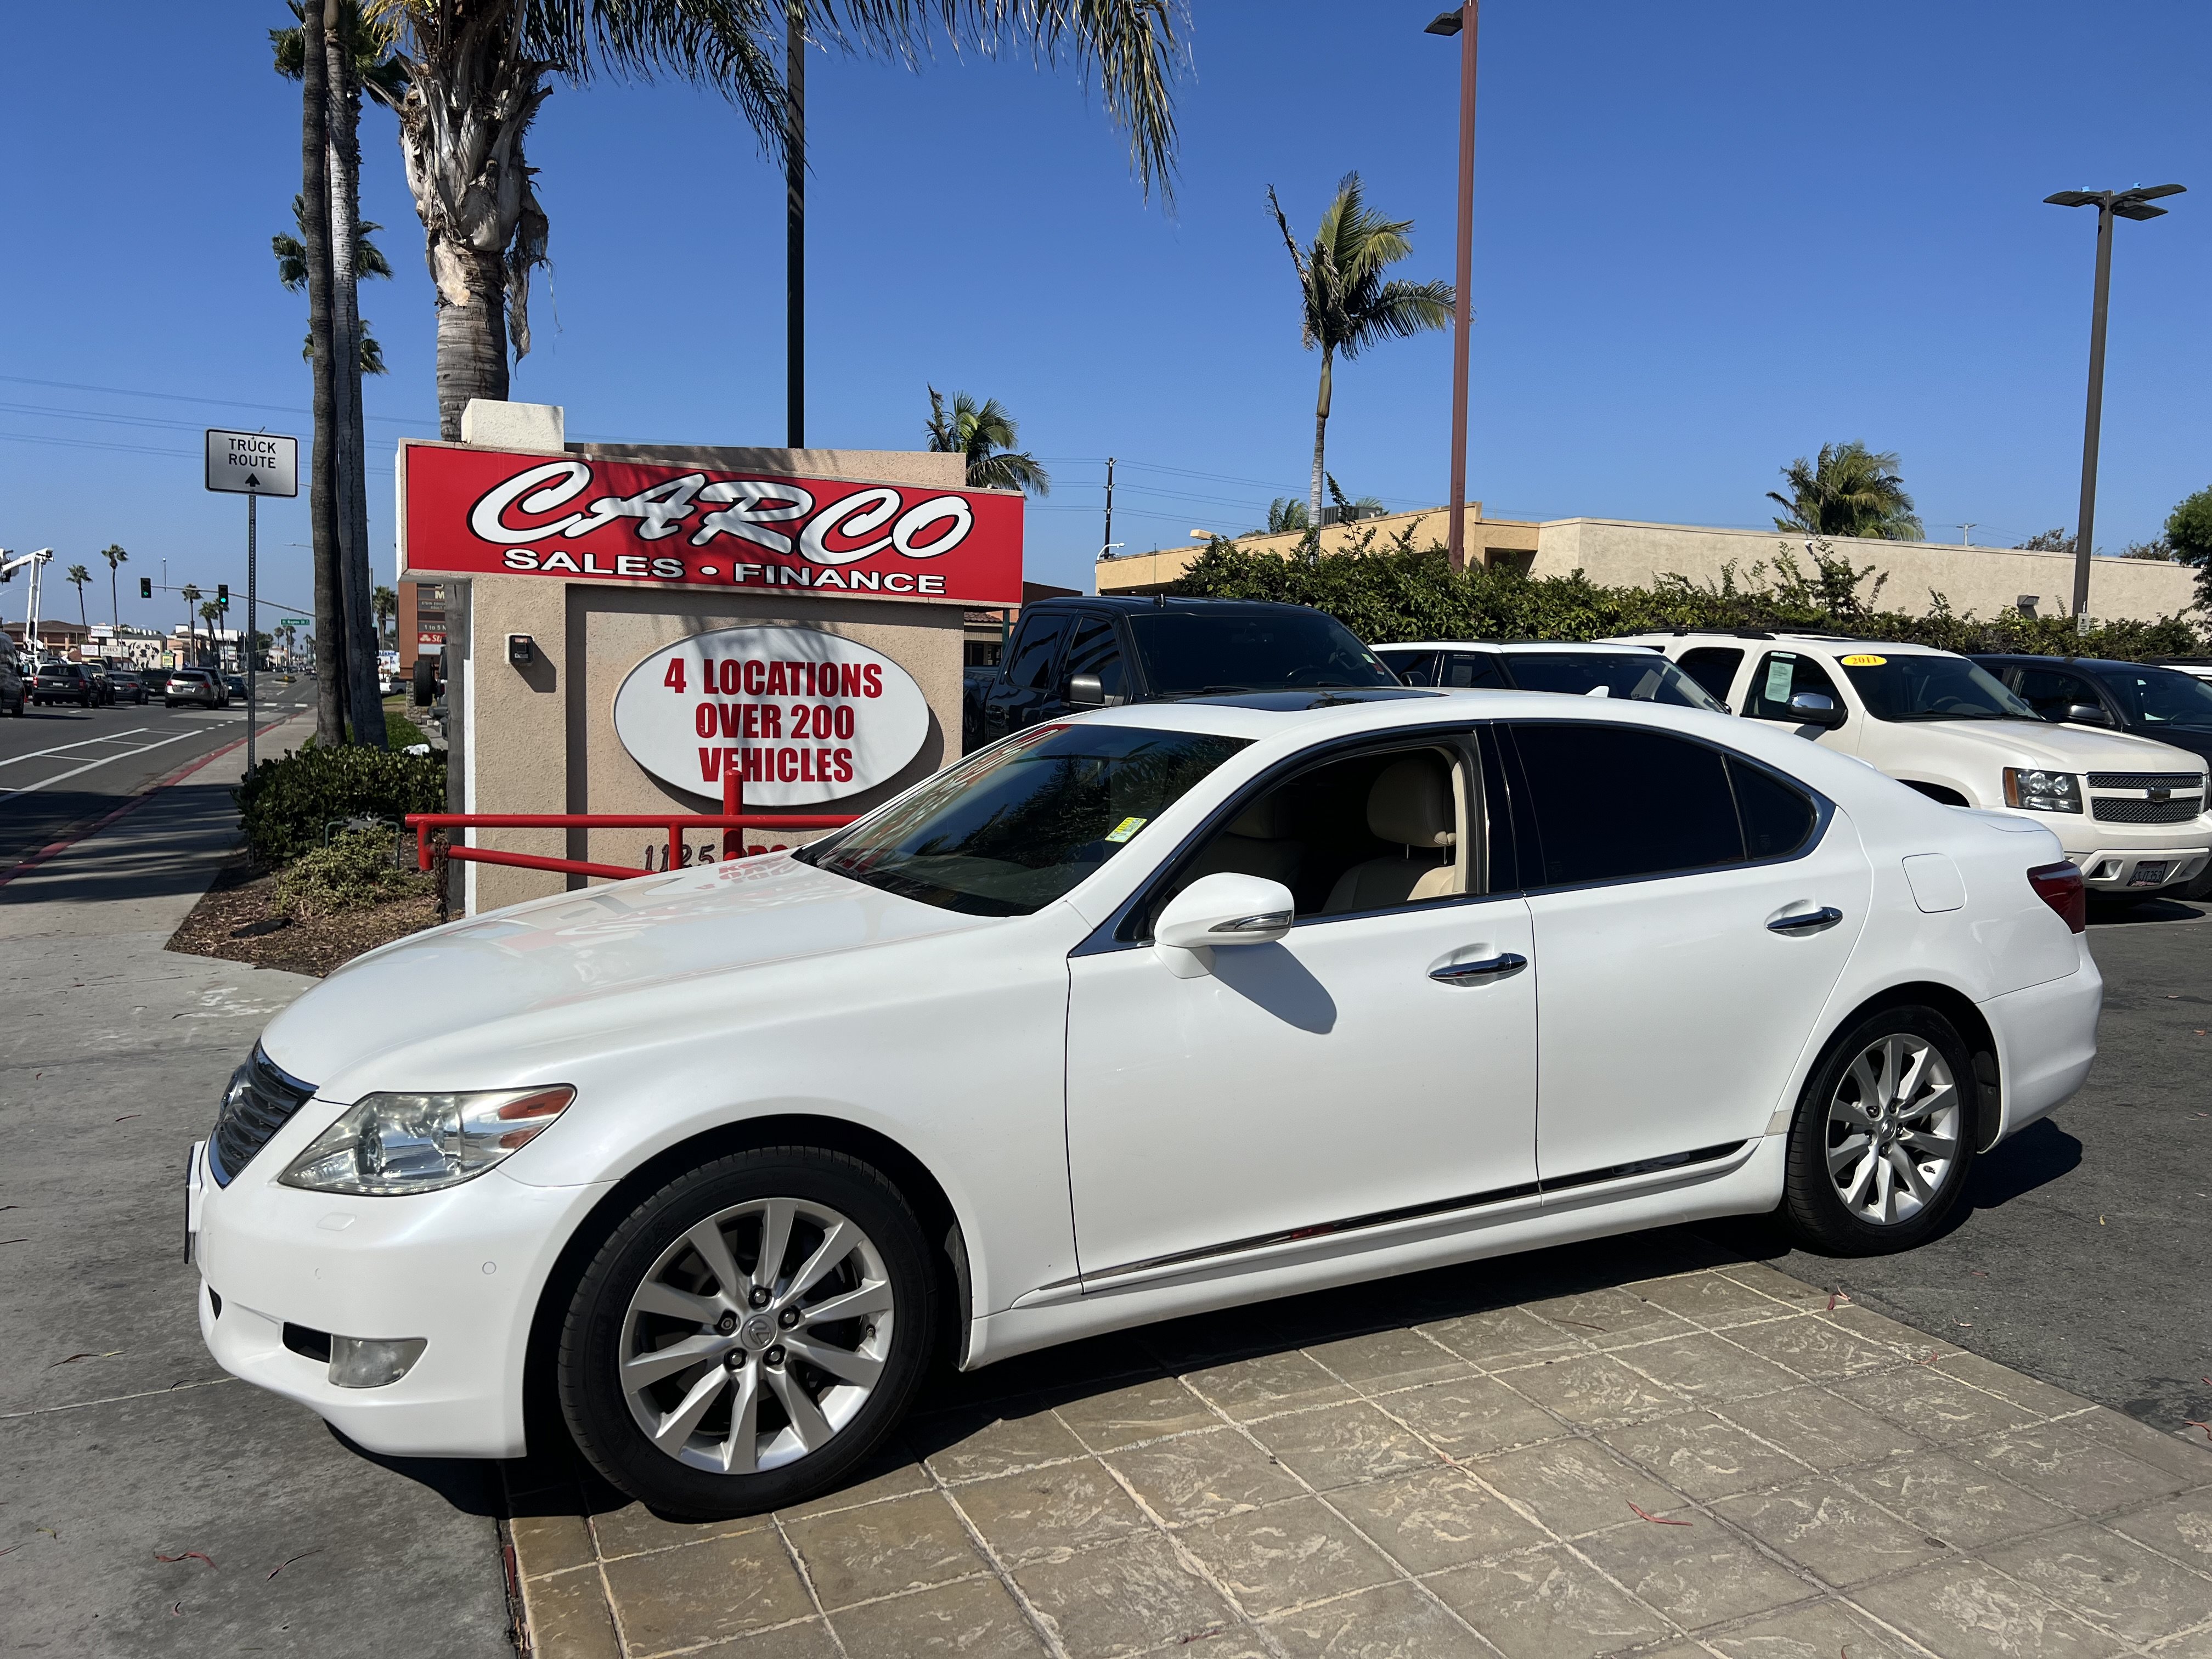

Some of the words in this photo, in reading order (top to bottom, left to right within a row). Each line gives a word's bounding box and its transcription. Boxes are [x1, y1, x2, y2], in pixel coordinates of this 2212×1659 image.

[228, 438, 276, 454] TRUCK
[229, 453, 276, 469] ROUTE
[468, 461, 974, 565] CARCO
[503, 548, 685, 578] SALES
[734, 563, 946, 594] FINANCE
[664, 658, 686, 693] 4
[704, 658, 882, 698] LOCATIONS
[696, 703, 781, 738] OVER
[791, 704, 854, 740] 200
[698, 747, 853, 782] VEHICLES
[645, 844, 715, 872] 1125
